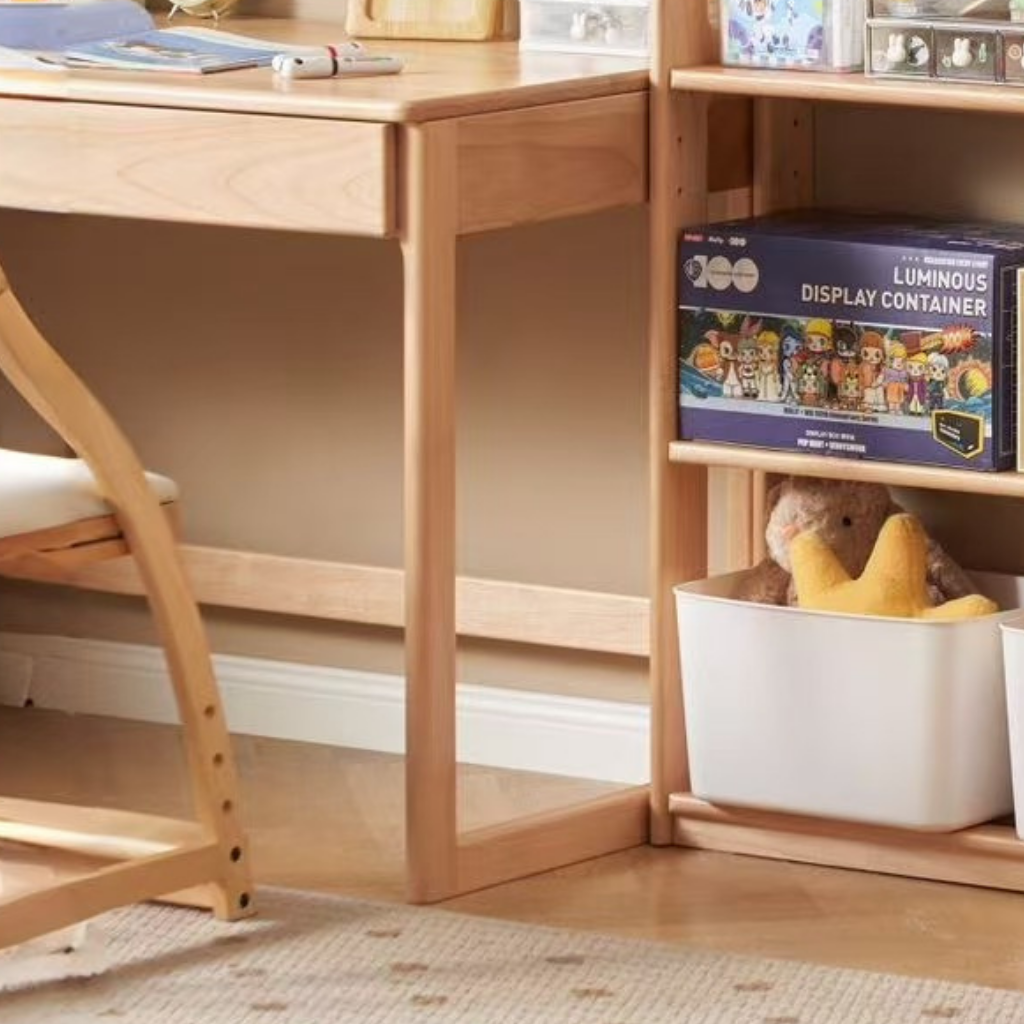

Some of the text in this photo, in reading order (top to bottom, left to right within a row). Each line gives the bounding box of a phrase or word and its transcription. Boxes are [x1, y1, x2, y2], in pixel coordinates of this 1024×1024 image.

[893, 266, 988, 292] LUMINOUS
[801, 283, 987, 317] DISPLAY CONTAINER
